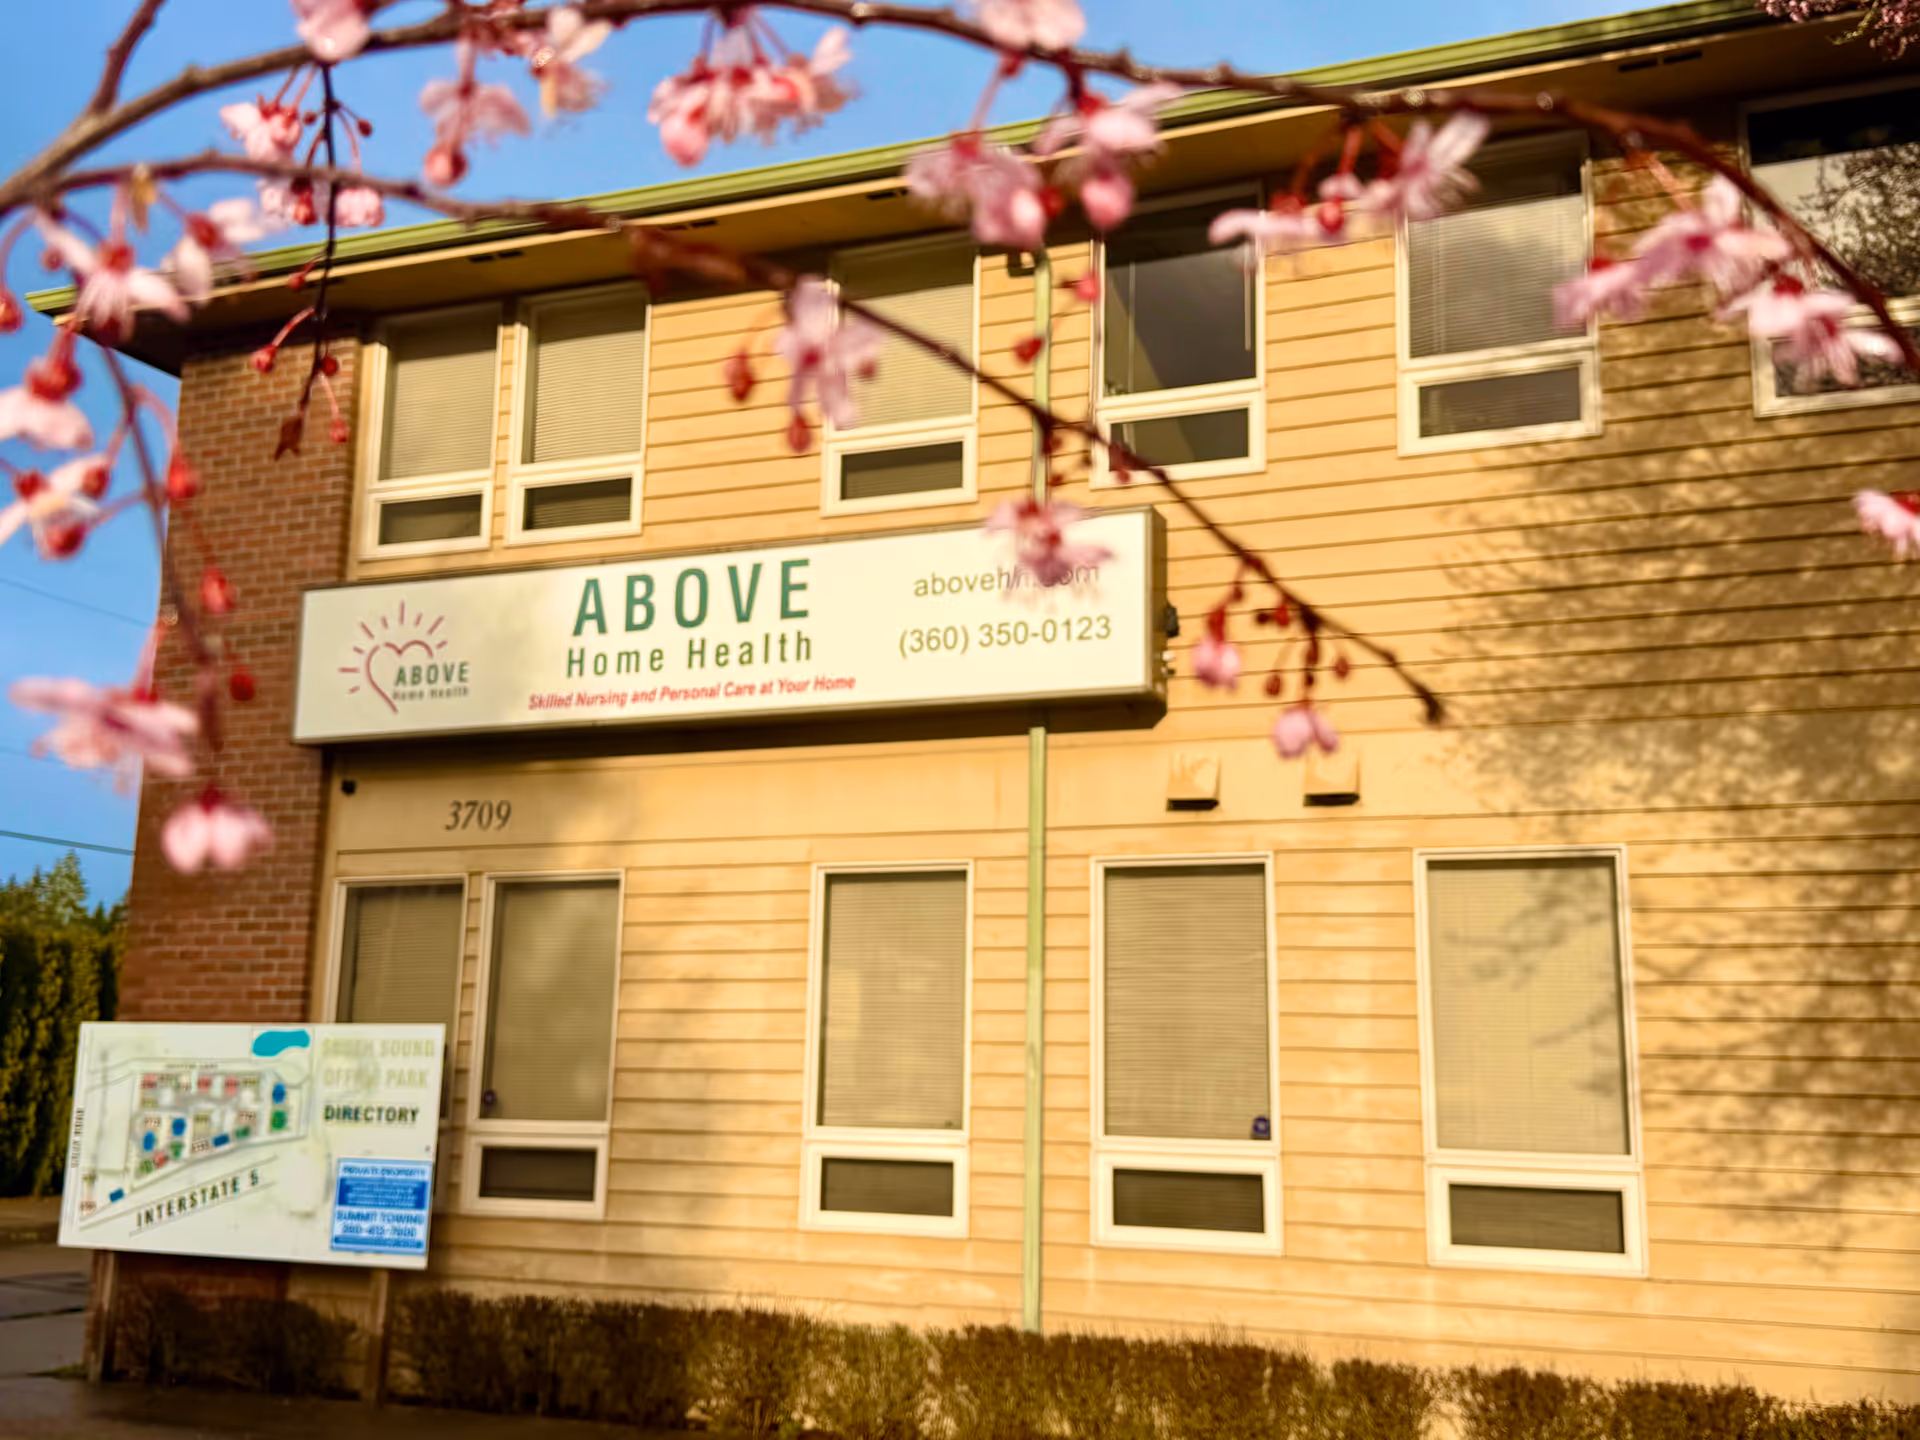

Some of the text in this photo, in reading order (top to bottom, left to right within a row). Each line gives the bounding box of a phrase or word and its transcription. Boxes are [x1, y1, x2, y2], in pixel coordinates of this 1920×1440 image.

[573, 558, 810, 637] ABOVE
[567, 630, 812, 679] Home Health
[899, 615, 1111, 660] (360) 350-0123
[394, 661, 469, 687] ABOVE
[528, 674, 857, 711] Skilled Nursing and Personal Care at Your Home
[445, 800, 512, 831] 3709
[386, 1067, 429, 1089] PARK
[324, 1105, 419, 1123] DIRECTORY
[136, 1168, 259, 1228] INTERSTATE 5
